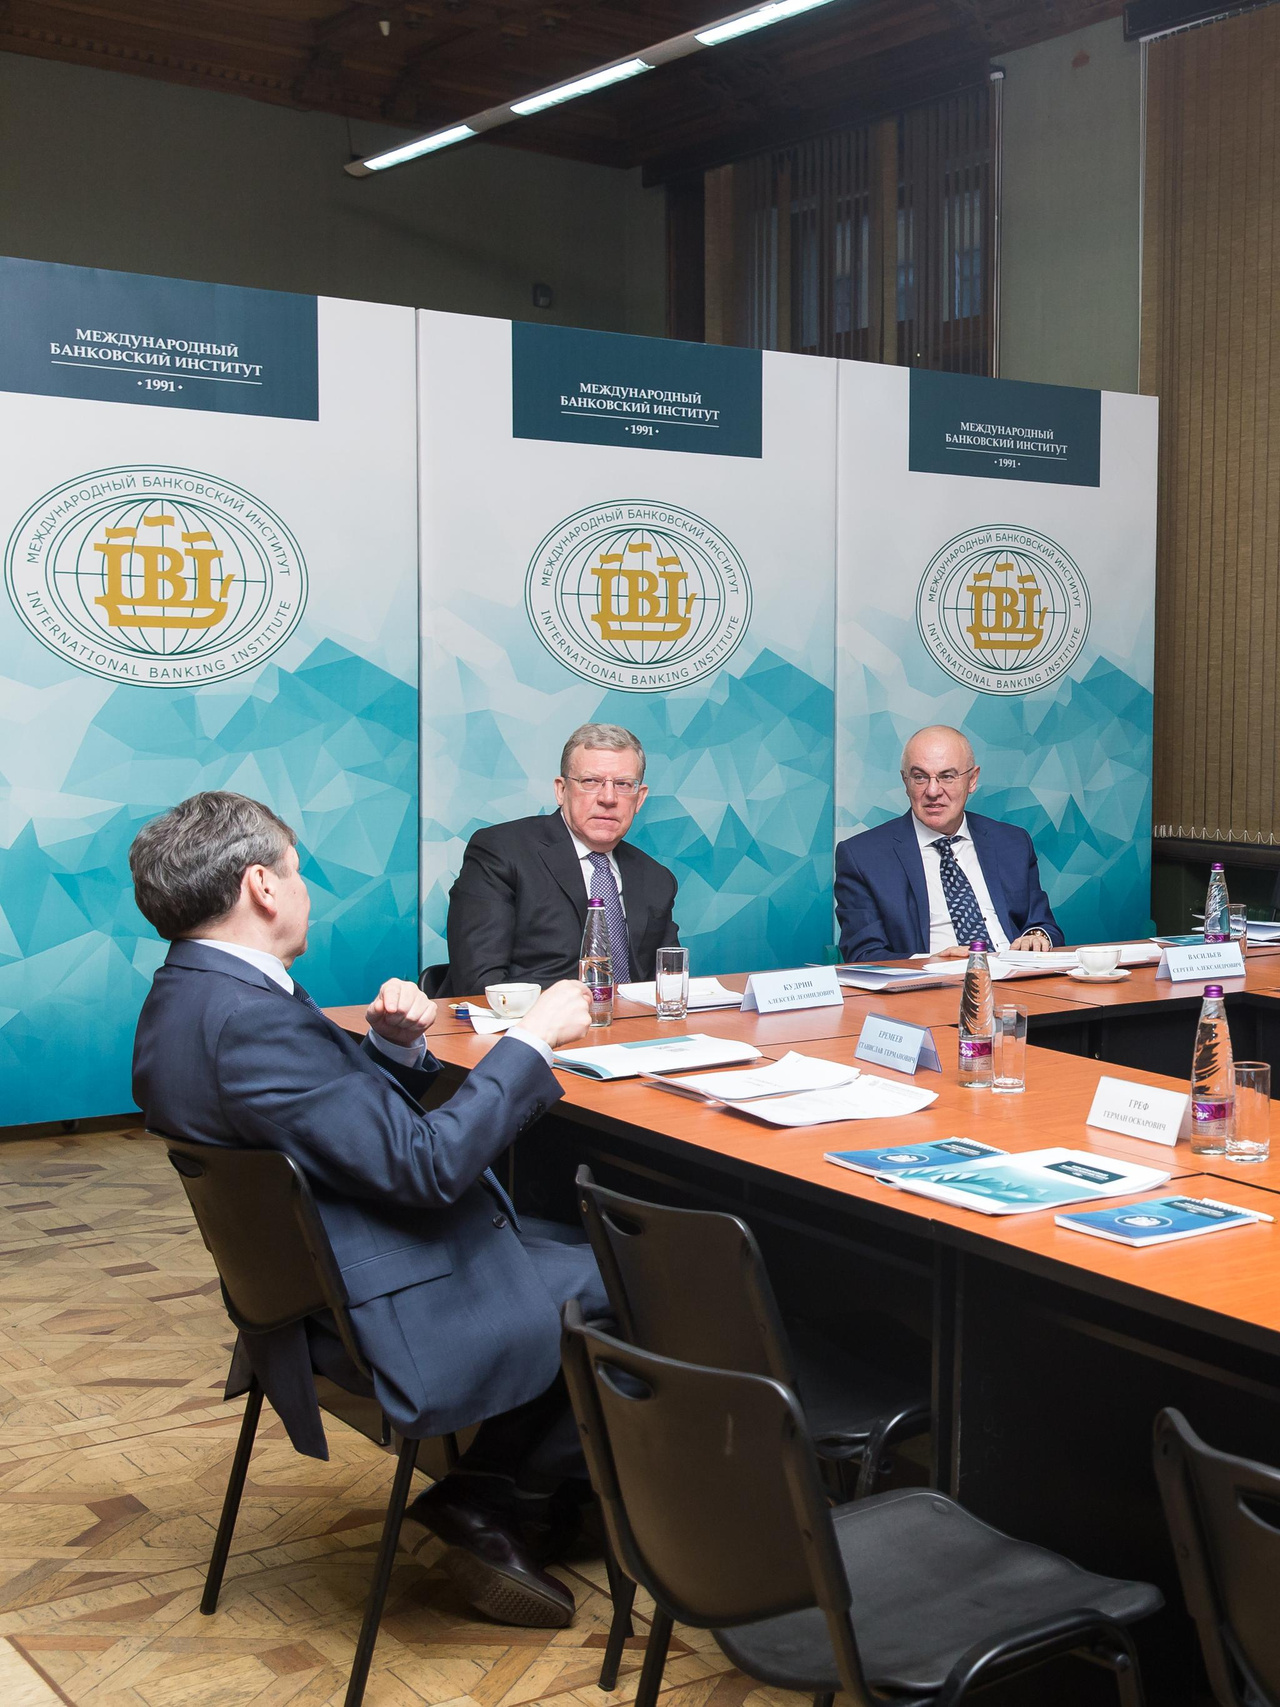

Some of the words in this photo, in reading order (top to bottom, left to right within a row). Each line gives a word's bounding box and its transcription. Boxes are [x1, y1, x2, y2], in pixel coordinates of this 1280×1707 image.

[75, 328, 239, 358] МЕЖДУНАРОДНЫЙ
[50, 342, 171, 368] БАНКОВСКИЙ
[175, 355, 263, 377] ИНСТИТУТ
[145, 378, 175, 392] 1991
[579, 382, 702, 405] МЕЖДУНАРОДНЫЙ
[560, 395, 651, 414] БАНКОВСКИЙ
[653, 404, 720, 421] ИНСТИТУТ
[630, 424, 653, 436] 1991
[960, 421, 1054, 440] МЕЖДУНАРОДНЫЙ
[945, 433, 1014, 449] БАНКОВСКИЙ
[1016, 440, 1068, 454] ИНСТИТУТ
[998, 458, 1016, 468] 1991
[27, 474, 138, 564] МЕЖДУНАРОДНЫЙ
[142, 475, 246, 512] БАНКОВСКИЙ
[246, 509, 291, 576] ИНСТИТУТ
[541, 508, 624, 587] МЕЖДУНАРОДНЫЙ
[627, 508, 705, 540] БАНКОВСКИЙ
[705, 537, 739, 595] ИНСТИТУТ
[928, 532, 993, 602] МЕЖДУНАРОДНЫЙ
[995, 533, 1055, 560] БАНКОВСКИЙ
[1054, 557, 1081, 608] ИНСТИТУТ
[27, 590, 140, 677] INTERNATIONAL
[149, 659, 227, 679] BANKING
[232, 600, 292, 664] INSTITUTE
[540, 610, 625, 684] INTERNATIONAL
[631, 668, 690, 685] BANKING
[693, 615, 740, 673] INSTITUTE
[927, 622, 991, 688] INTERNATIONAL
[996, 674, 1042, 689] BANKING
[1045, 627, 1081, 677] INSTITUTE
[1188, 952, 1222, 961] ВАСИЛЬЕВ
[783, 980, 813, 991] КУДРИН
[767, 994, 796, 1005] АЛЕКСЕЙ
[796, 989, 835, 1001] ЛЕОНИДОВИЧ
[878, 1030, 904, 1043] ЕРЕМЕЕВ
[1128, 1098, 1150, 1111] ГРЕФ
[1103, 1110, 1128, 1126] ГЕРМАН
[1128, 1115, 1167, 1132] ОСКАРОВИЧ
